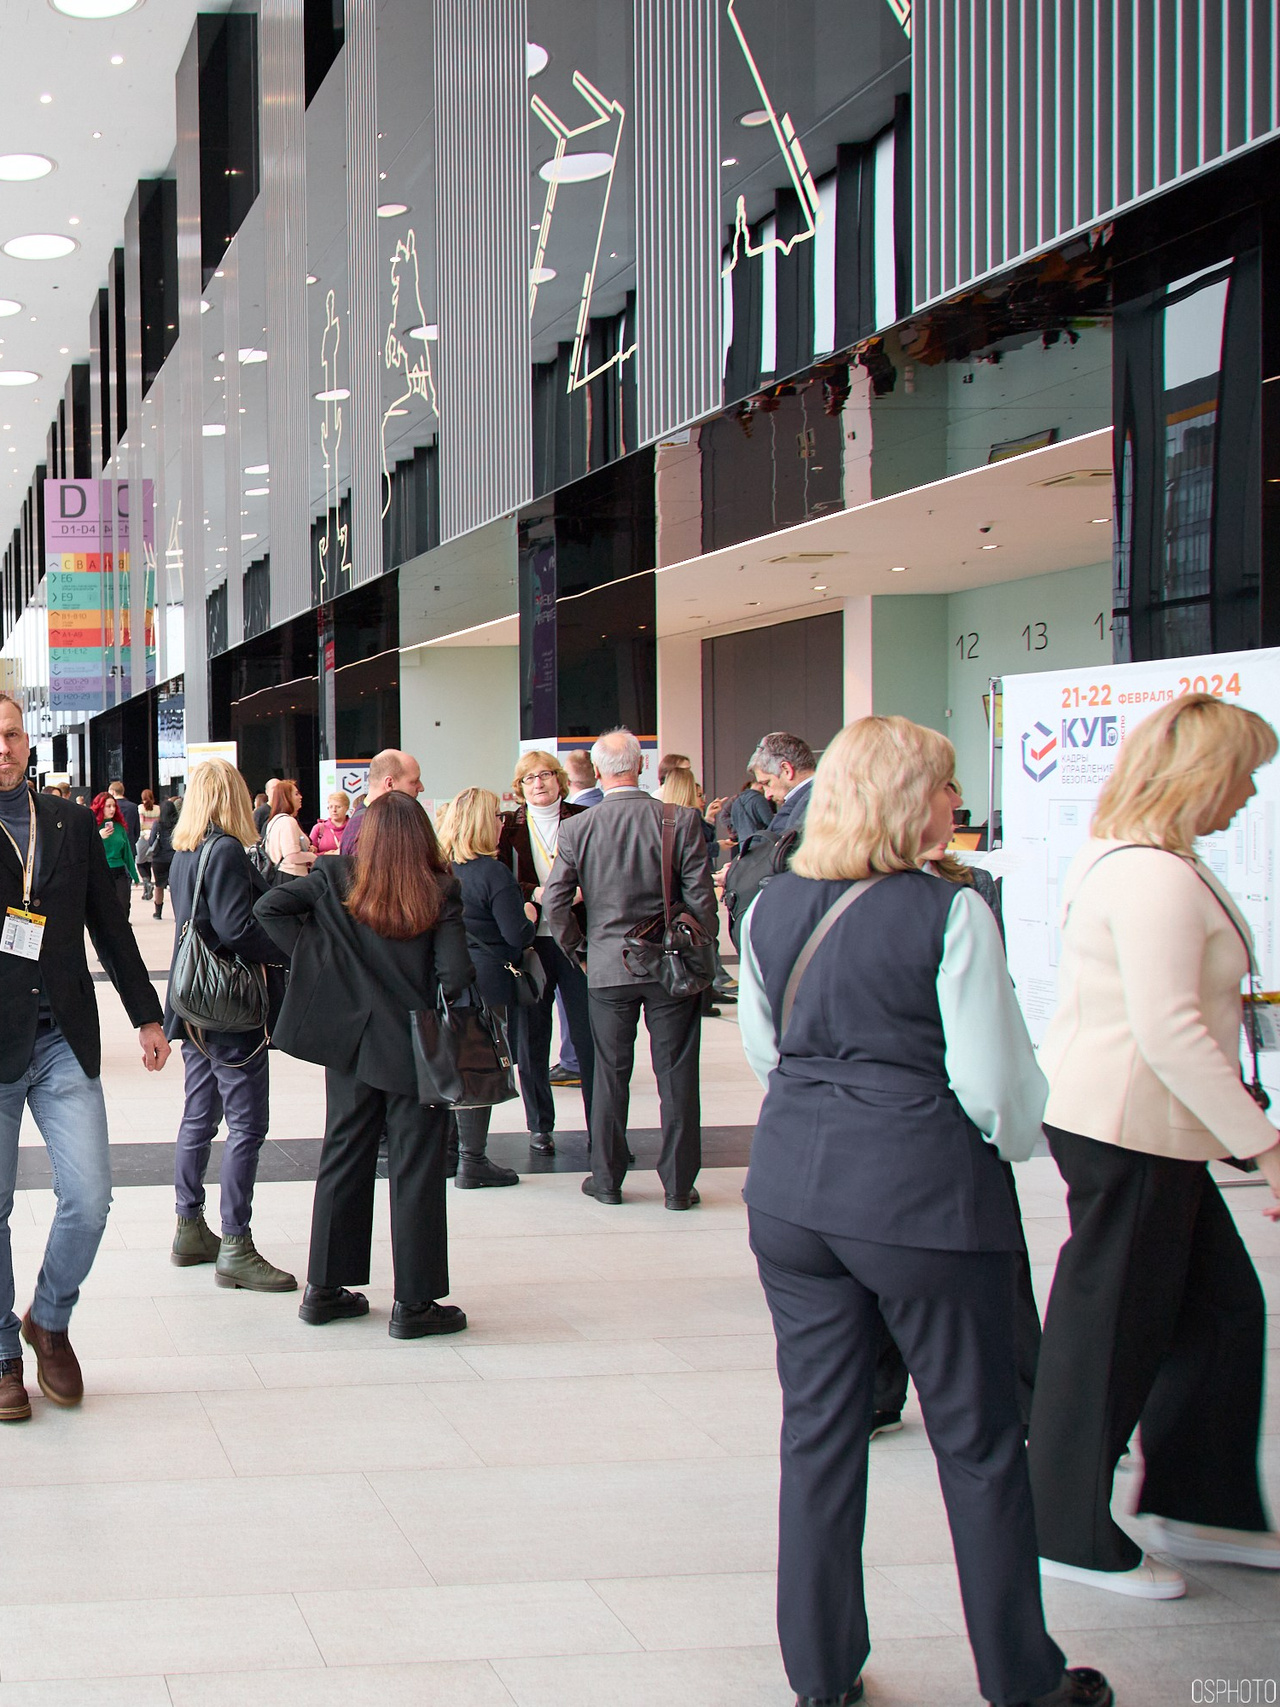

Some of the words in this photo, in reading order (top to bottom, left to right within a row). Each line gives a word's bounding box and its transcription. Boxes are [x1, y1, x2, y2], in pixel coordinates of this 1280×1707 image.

[60, 485, 86, 518] D
[61, 525, 95, 534] D1-D4
[64, 560, 71, 569] C
[76, 560, 83, 569] B
[89, 560, 96, 569] A
[61, 574, 73, 583] E6
[61, 593, 73, 601] E9
[1022, 622, 1048, 651] 13
[956, 632, 980, 660] 12
[1062, 684, 1112, 708] 21-22
[1118, 690, 1174, 704] ФЕВРАЛЯ
[1178, 673, 1242, 699] 2024
[1062, 716, 1118, 748] КУБ
[1062, 754, 1089, 763] КАДРЫ
[1062, 764, 1115, 773] УПРАВЛЕНИЕ
